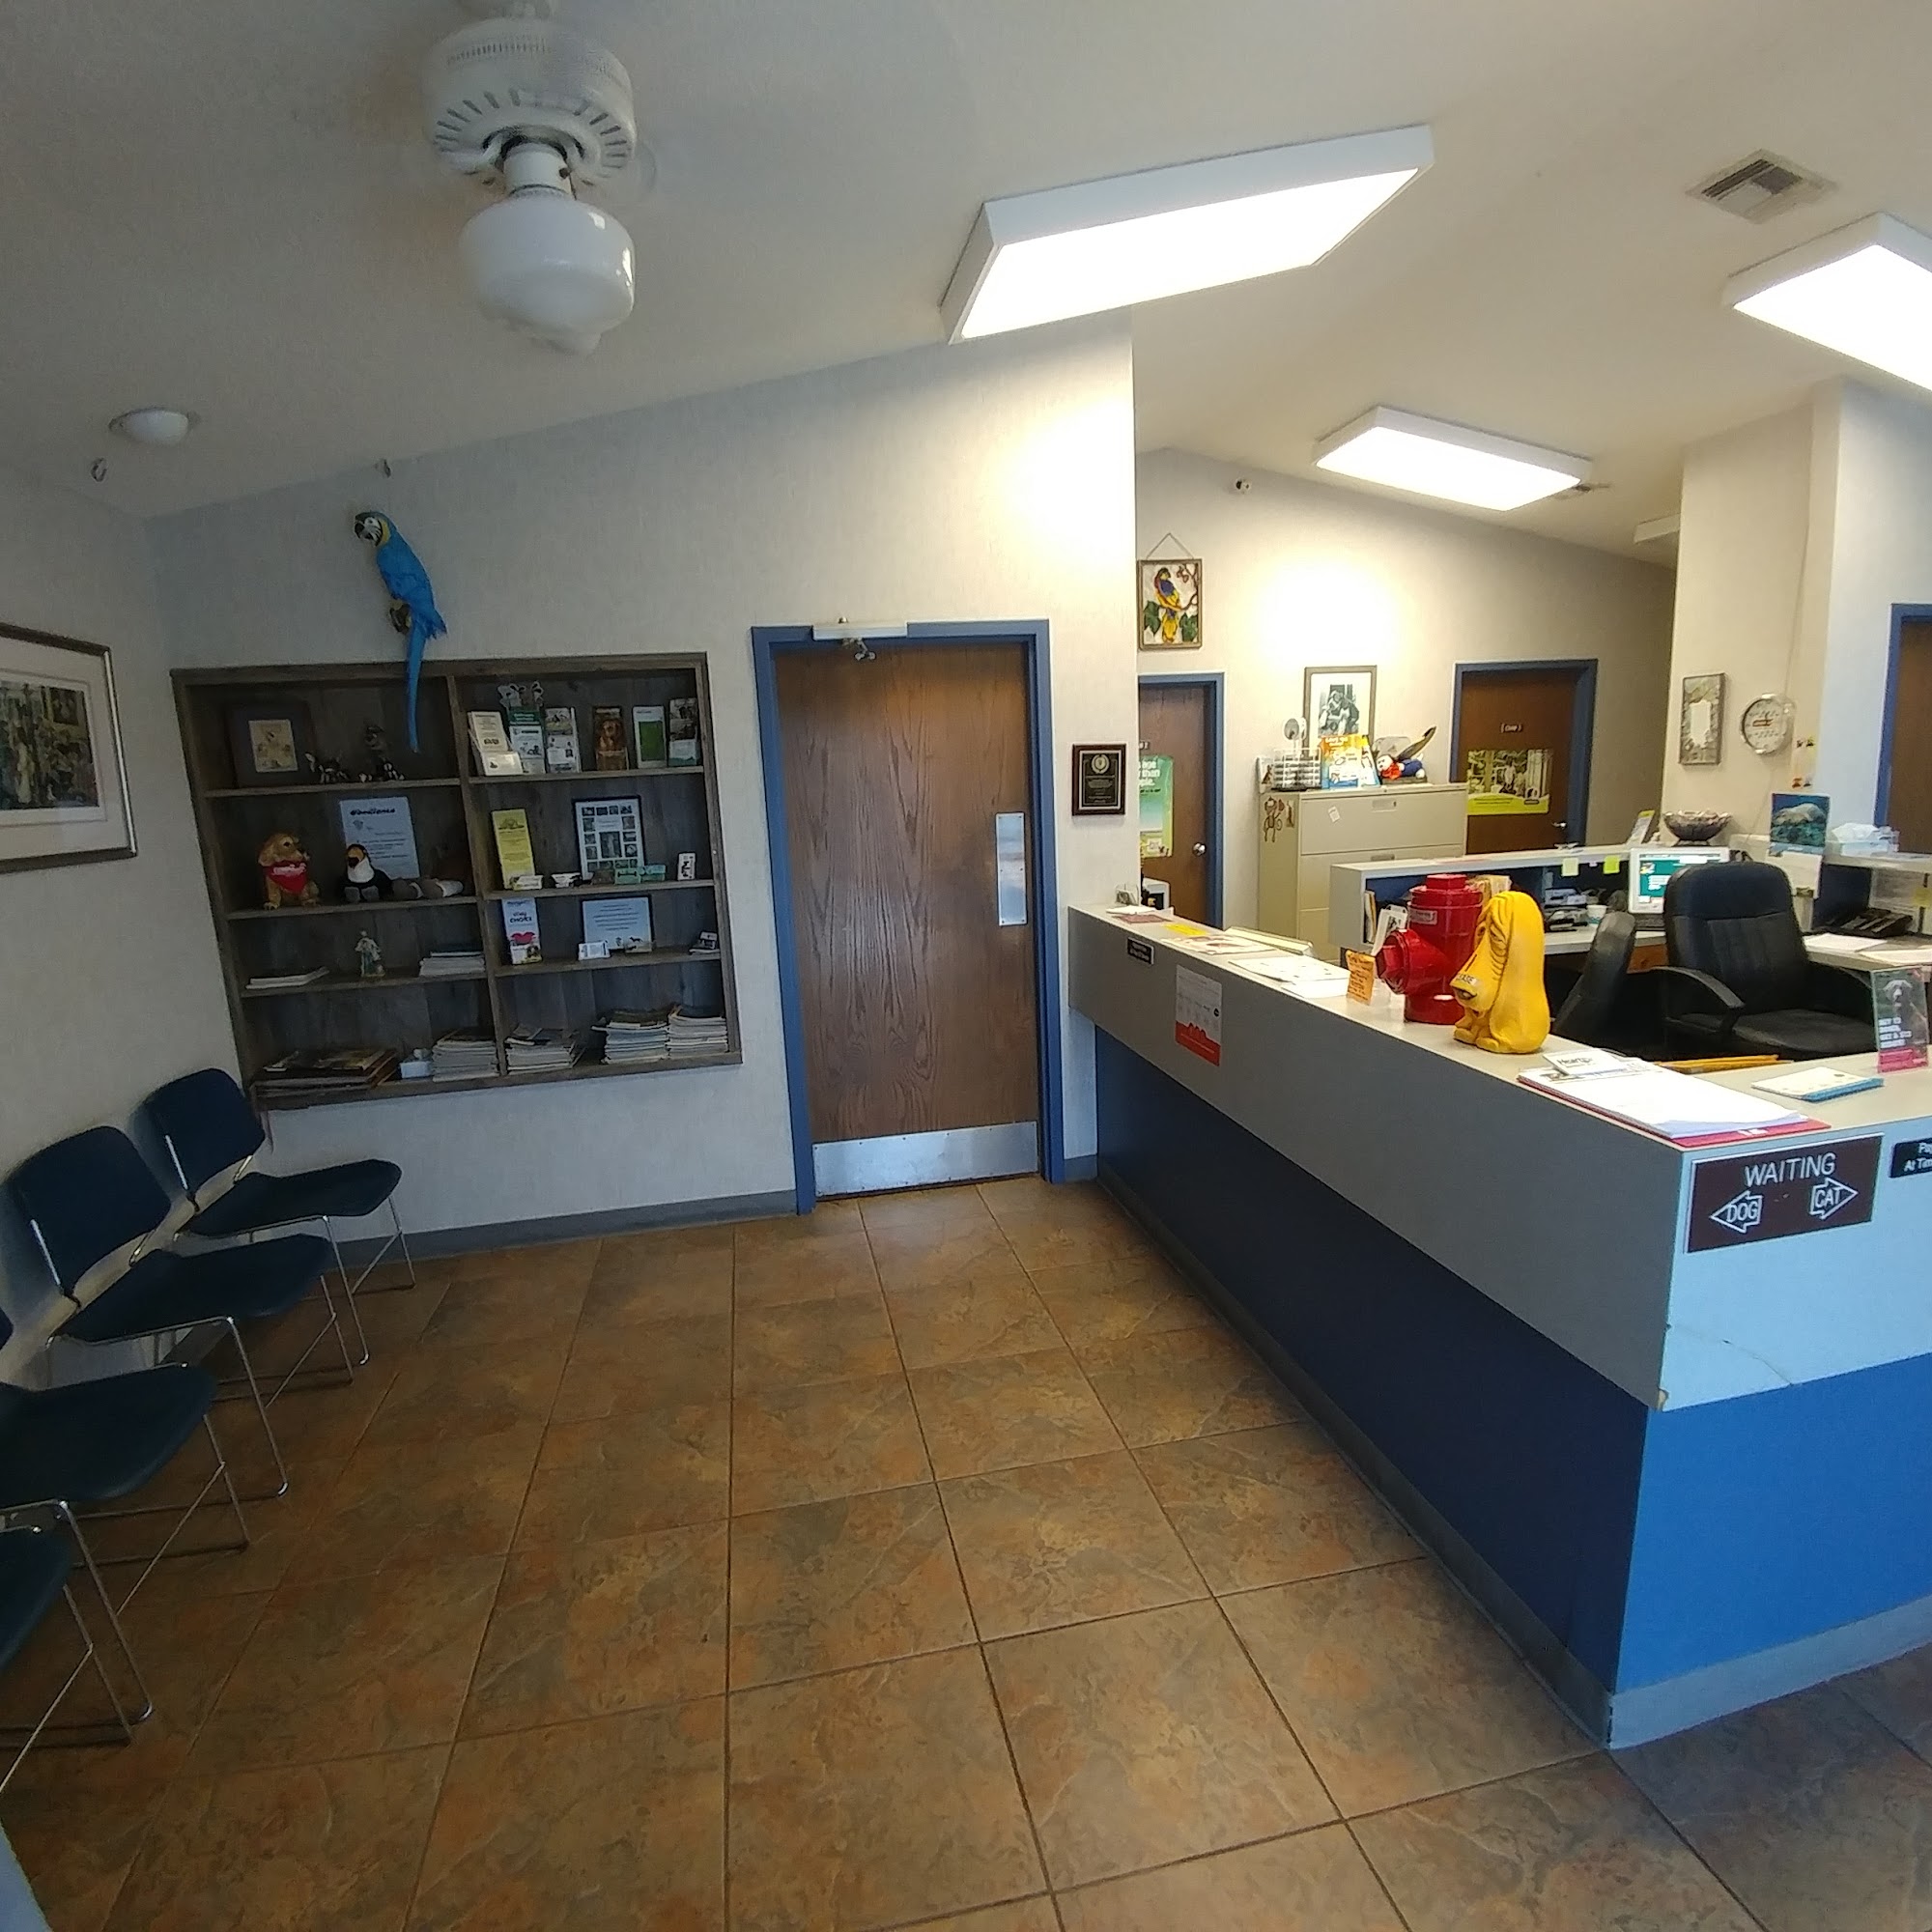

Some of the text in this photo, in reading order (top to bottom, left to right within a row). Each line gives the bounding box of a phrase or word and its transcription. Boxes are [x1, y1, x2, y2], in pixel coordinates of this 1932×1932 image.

[1745, 1152, 1836, 1187] WAITING
[1814, 1186, 1841, 1208] CAT
[1726, 1202, 1759, 1223] DOG
